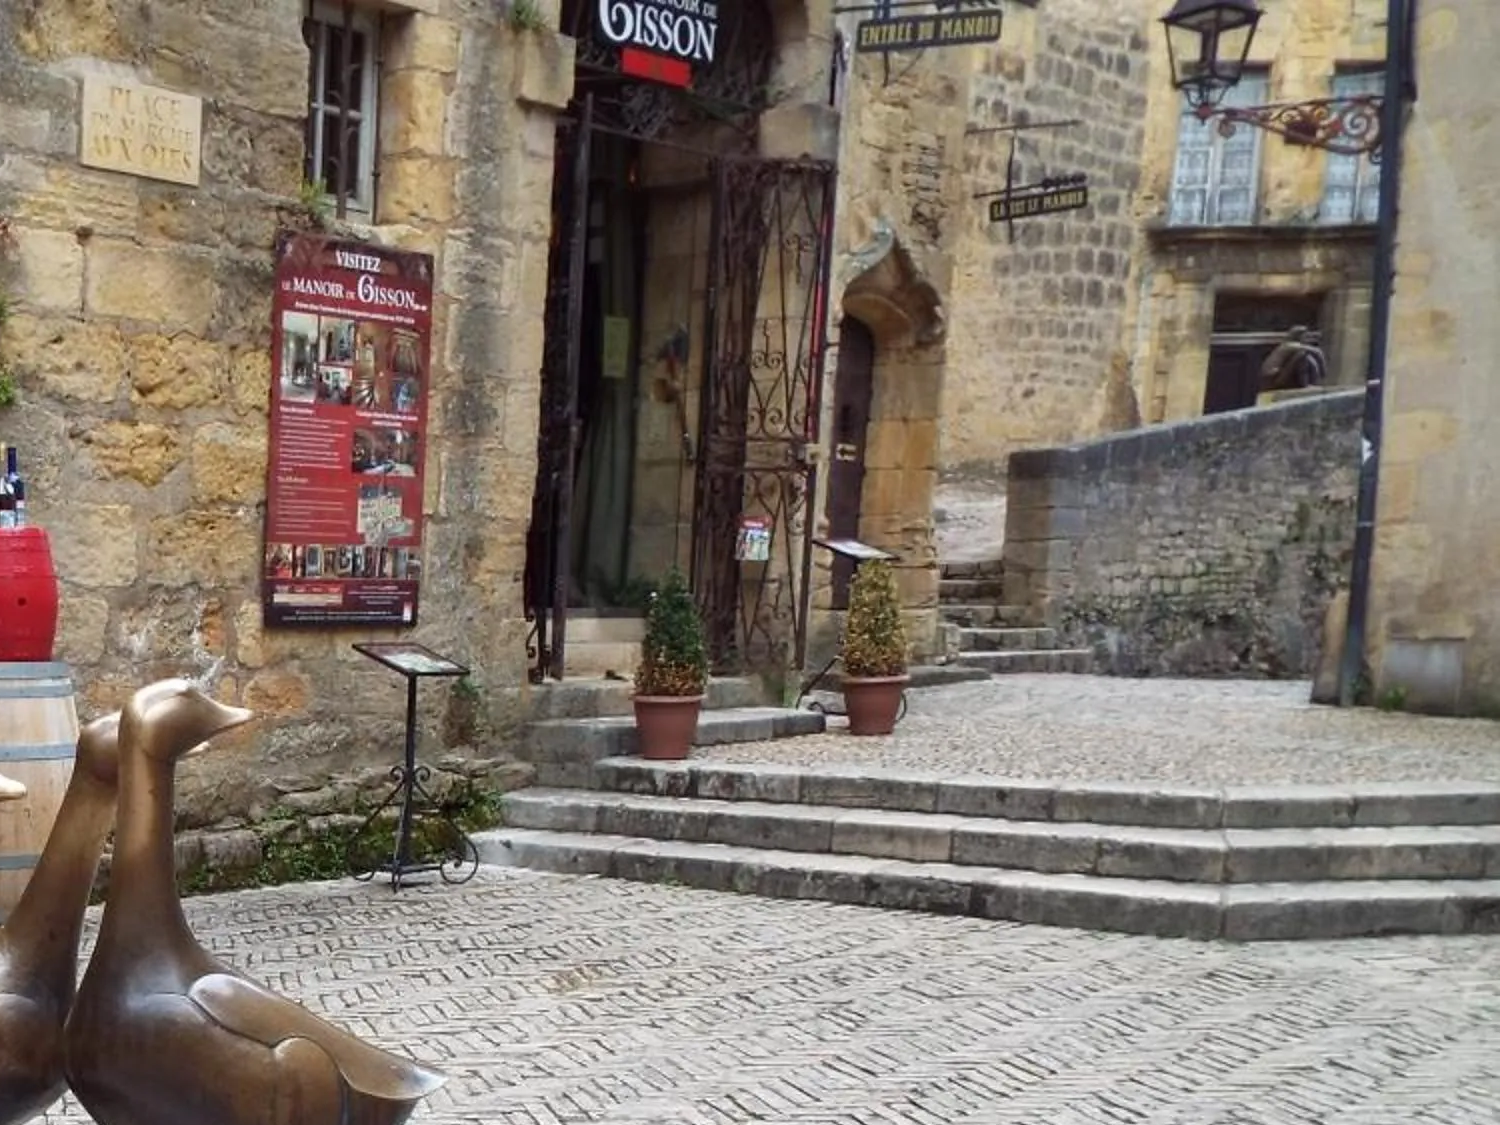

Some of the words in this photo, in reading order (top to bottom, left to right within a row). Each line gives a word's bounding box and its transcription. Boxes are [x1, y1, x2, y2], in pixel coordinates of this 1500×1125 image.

[599, 0, 718, 62] GISSON
[940, 14, 1000, 39] MANOIR
[335, 249, 381, 273] VISITEZ
[293, 276, 344, 299] MANOIR
